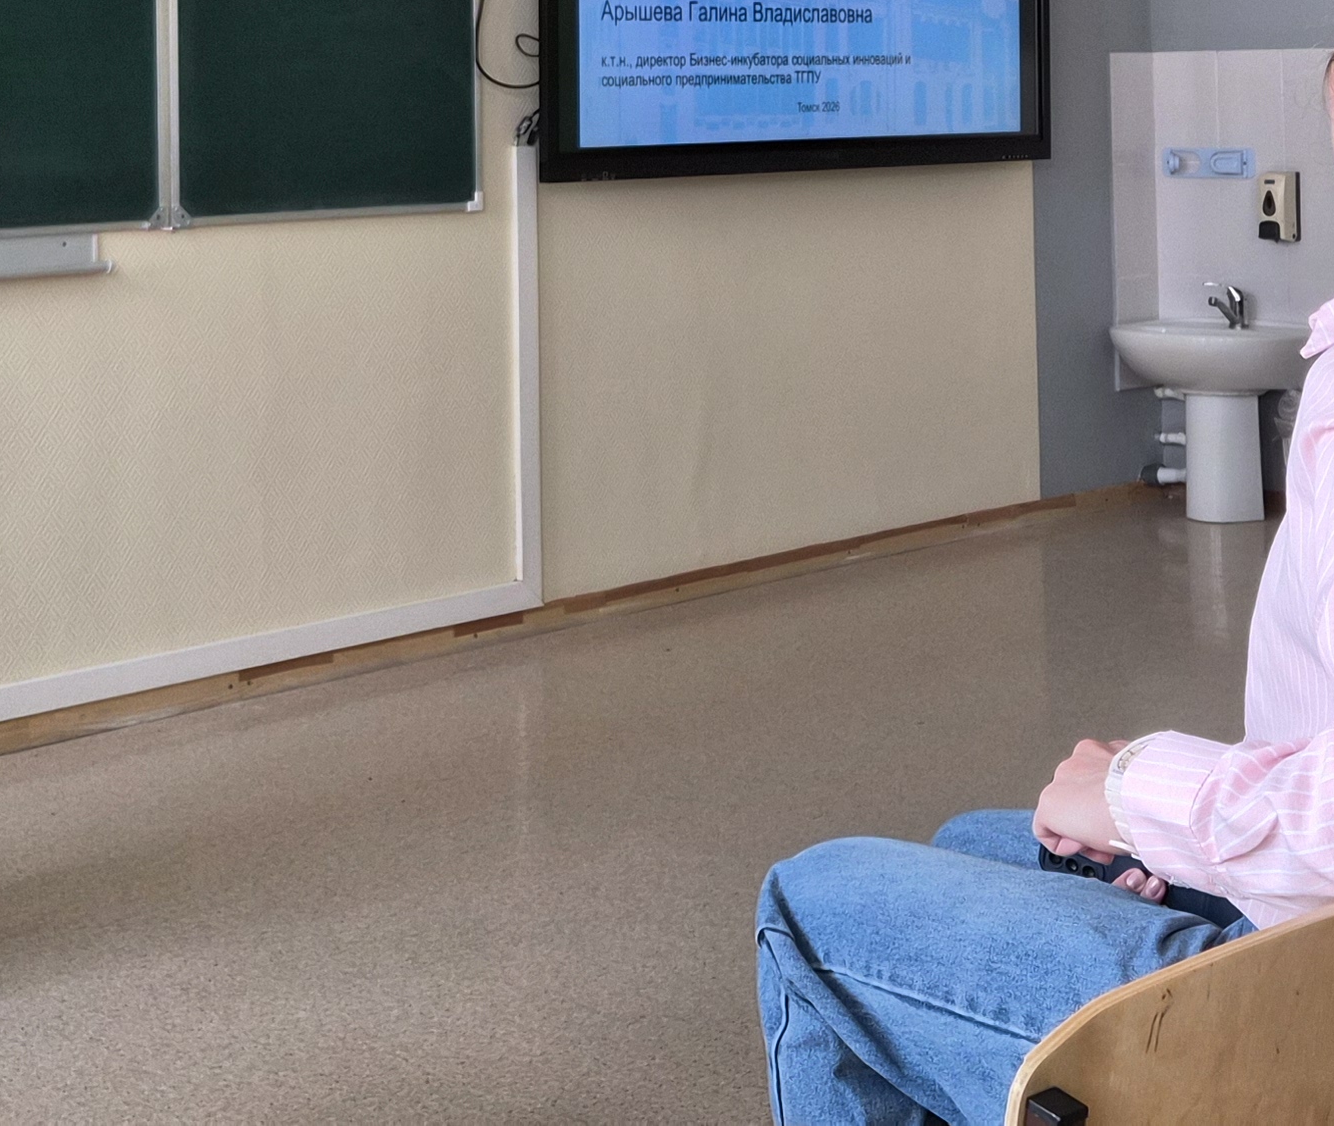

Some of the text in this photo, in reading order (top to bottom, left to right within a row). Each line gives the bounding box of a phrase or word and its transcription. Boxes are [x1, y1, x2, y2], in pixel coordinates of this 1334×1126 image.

[601, 0, 873, 26] Арышева Галина Владиславовна
[635, 54, 687, 70] директор
[689, 52, 788, 70] Бизнес-инкубатора
[791, 54, 850, 68] социальных
[852, 52, 903, 67] инноваций
[905, 54, 911, 65] и
[601, 70, 822, 89] социального предпринимательства ТГПУ
[797, 101, 820, 113] Томск
